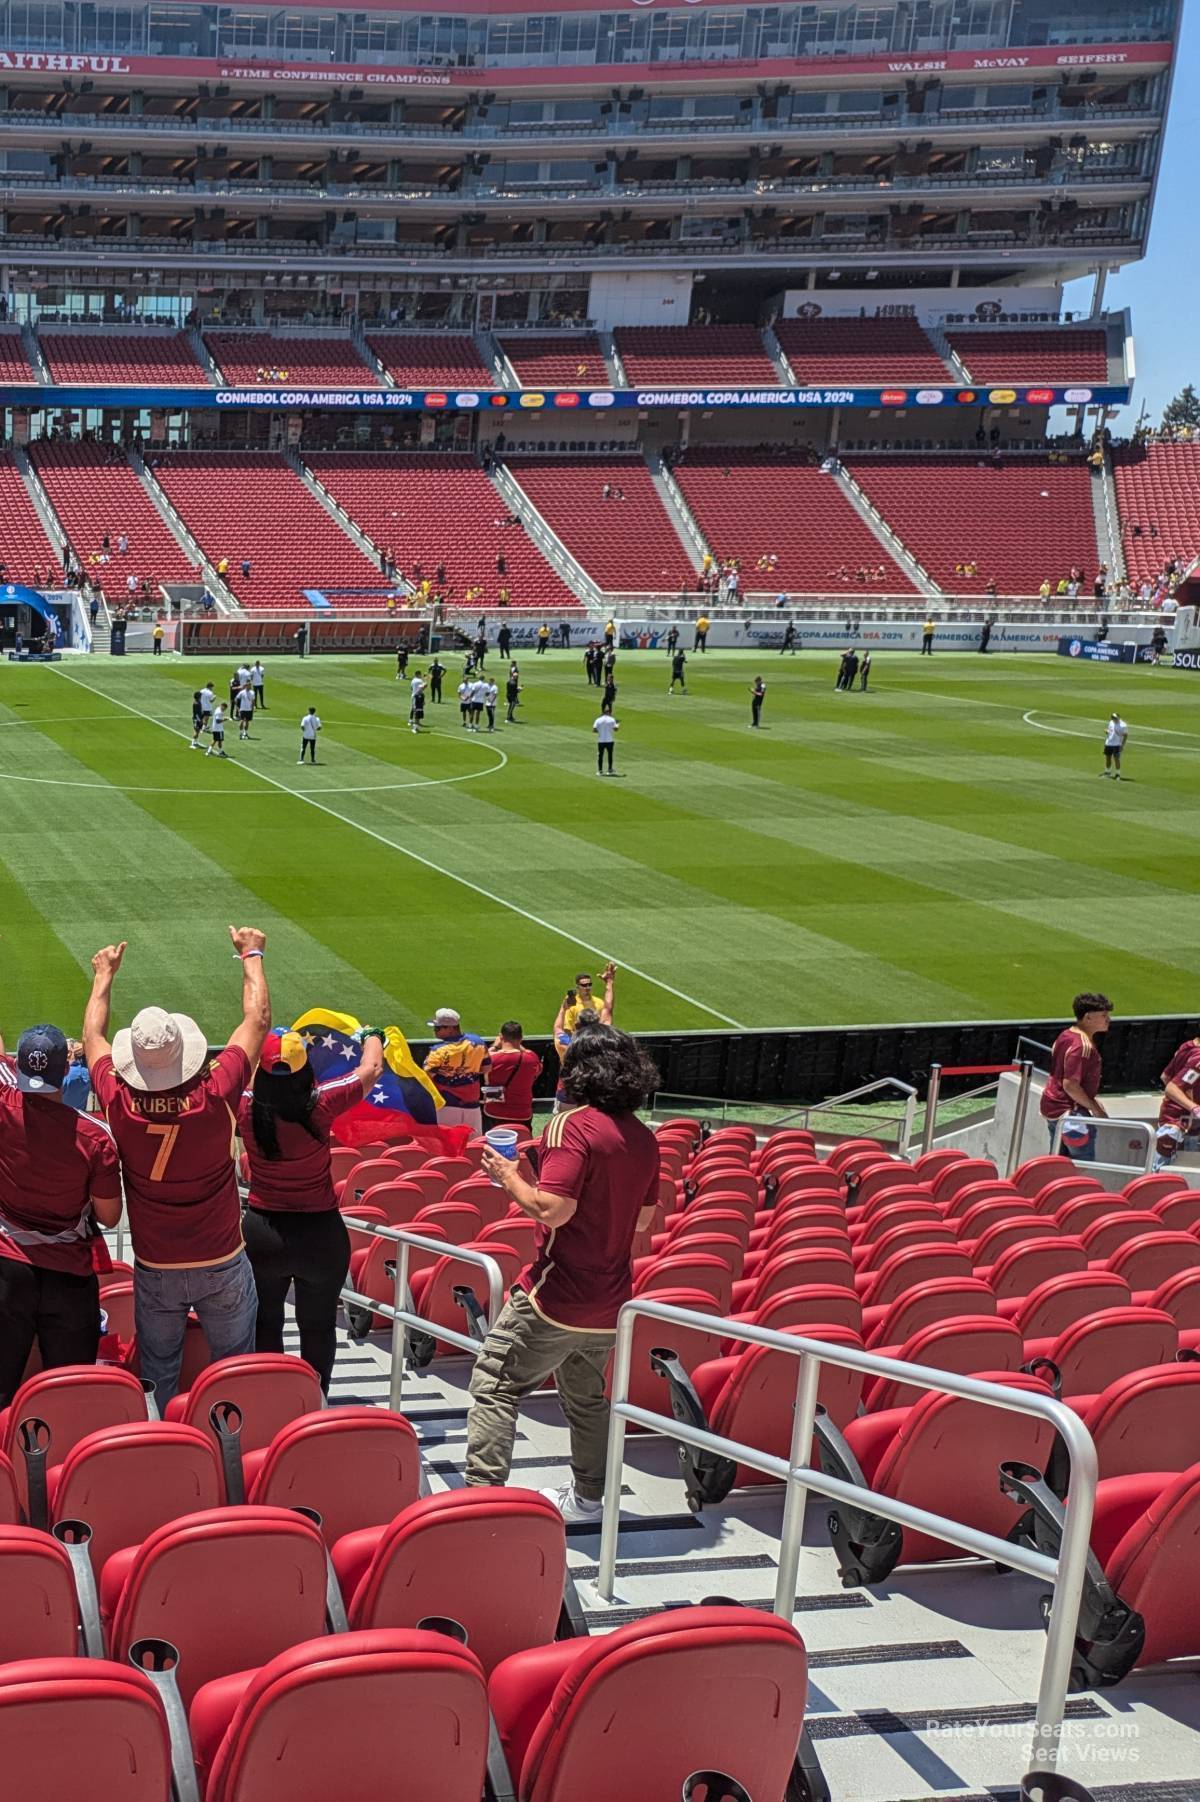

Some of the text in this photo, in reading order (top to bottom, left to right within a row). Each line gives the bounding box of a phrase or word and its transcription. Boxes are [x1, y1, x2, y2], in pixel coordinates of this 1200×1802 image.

[888, 54, 1127, 71] WALSH McVAY SEIFERT
[273, 71, 363, 83] CONFERENCE
[367, 73, 450, 85] CHAMPIONS
[216, 392, 412, 405] CONMEBOL COPA AMERICA USA 2024
[637, 391, 853, 405] CONMEBOL COPA AMERICA USA 2024
[131, 1096, 191, 1113] RUBEN
[145, 1123, 181, 1182] 7
[830, 1517, 838, 1531] 13
